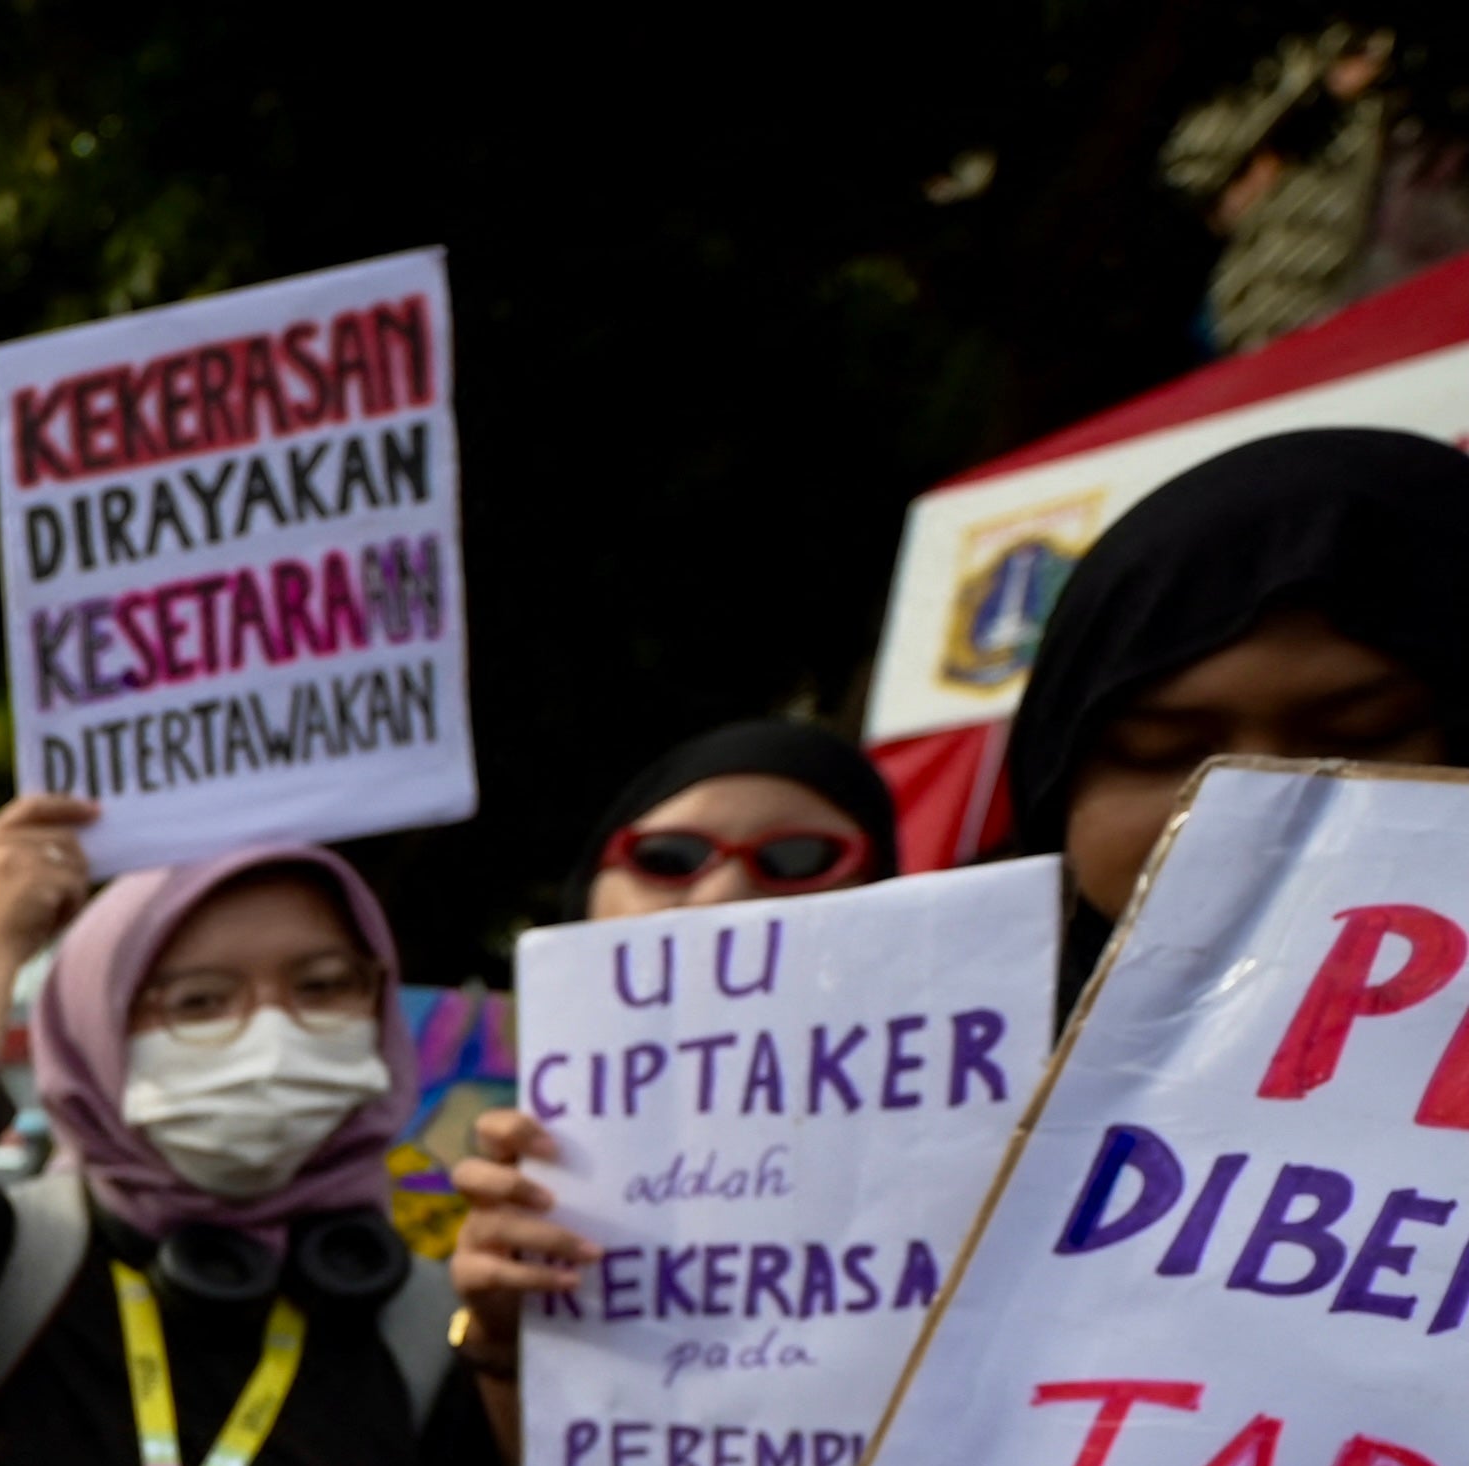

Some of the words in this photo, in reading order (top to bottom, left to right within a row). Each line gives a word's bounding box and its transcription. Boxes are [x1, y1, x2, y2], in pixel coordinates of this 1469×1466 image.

[12, 293, 438, 489] KEKERASAN
[24, 420, 432, 583] DIRAYAKAN
[41, 659, 437, 799] DITERTAWAKAN
[530, 1008, 1008, 1121] CIPTAKER
[1256, 904, 1469, 1132] P
[1052, 1123, 1469, 1336] DIBE
[662, 1327, 816, 1389] pada
